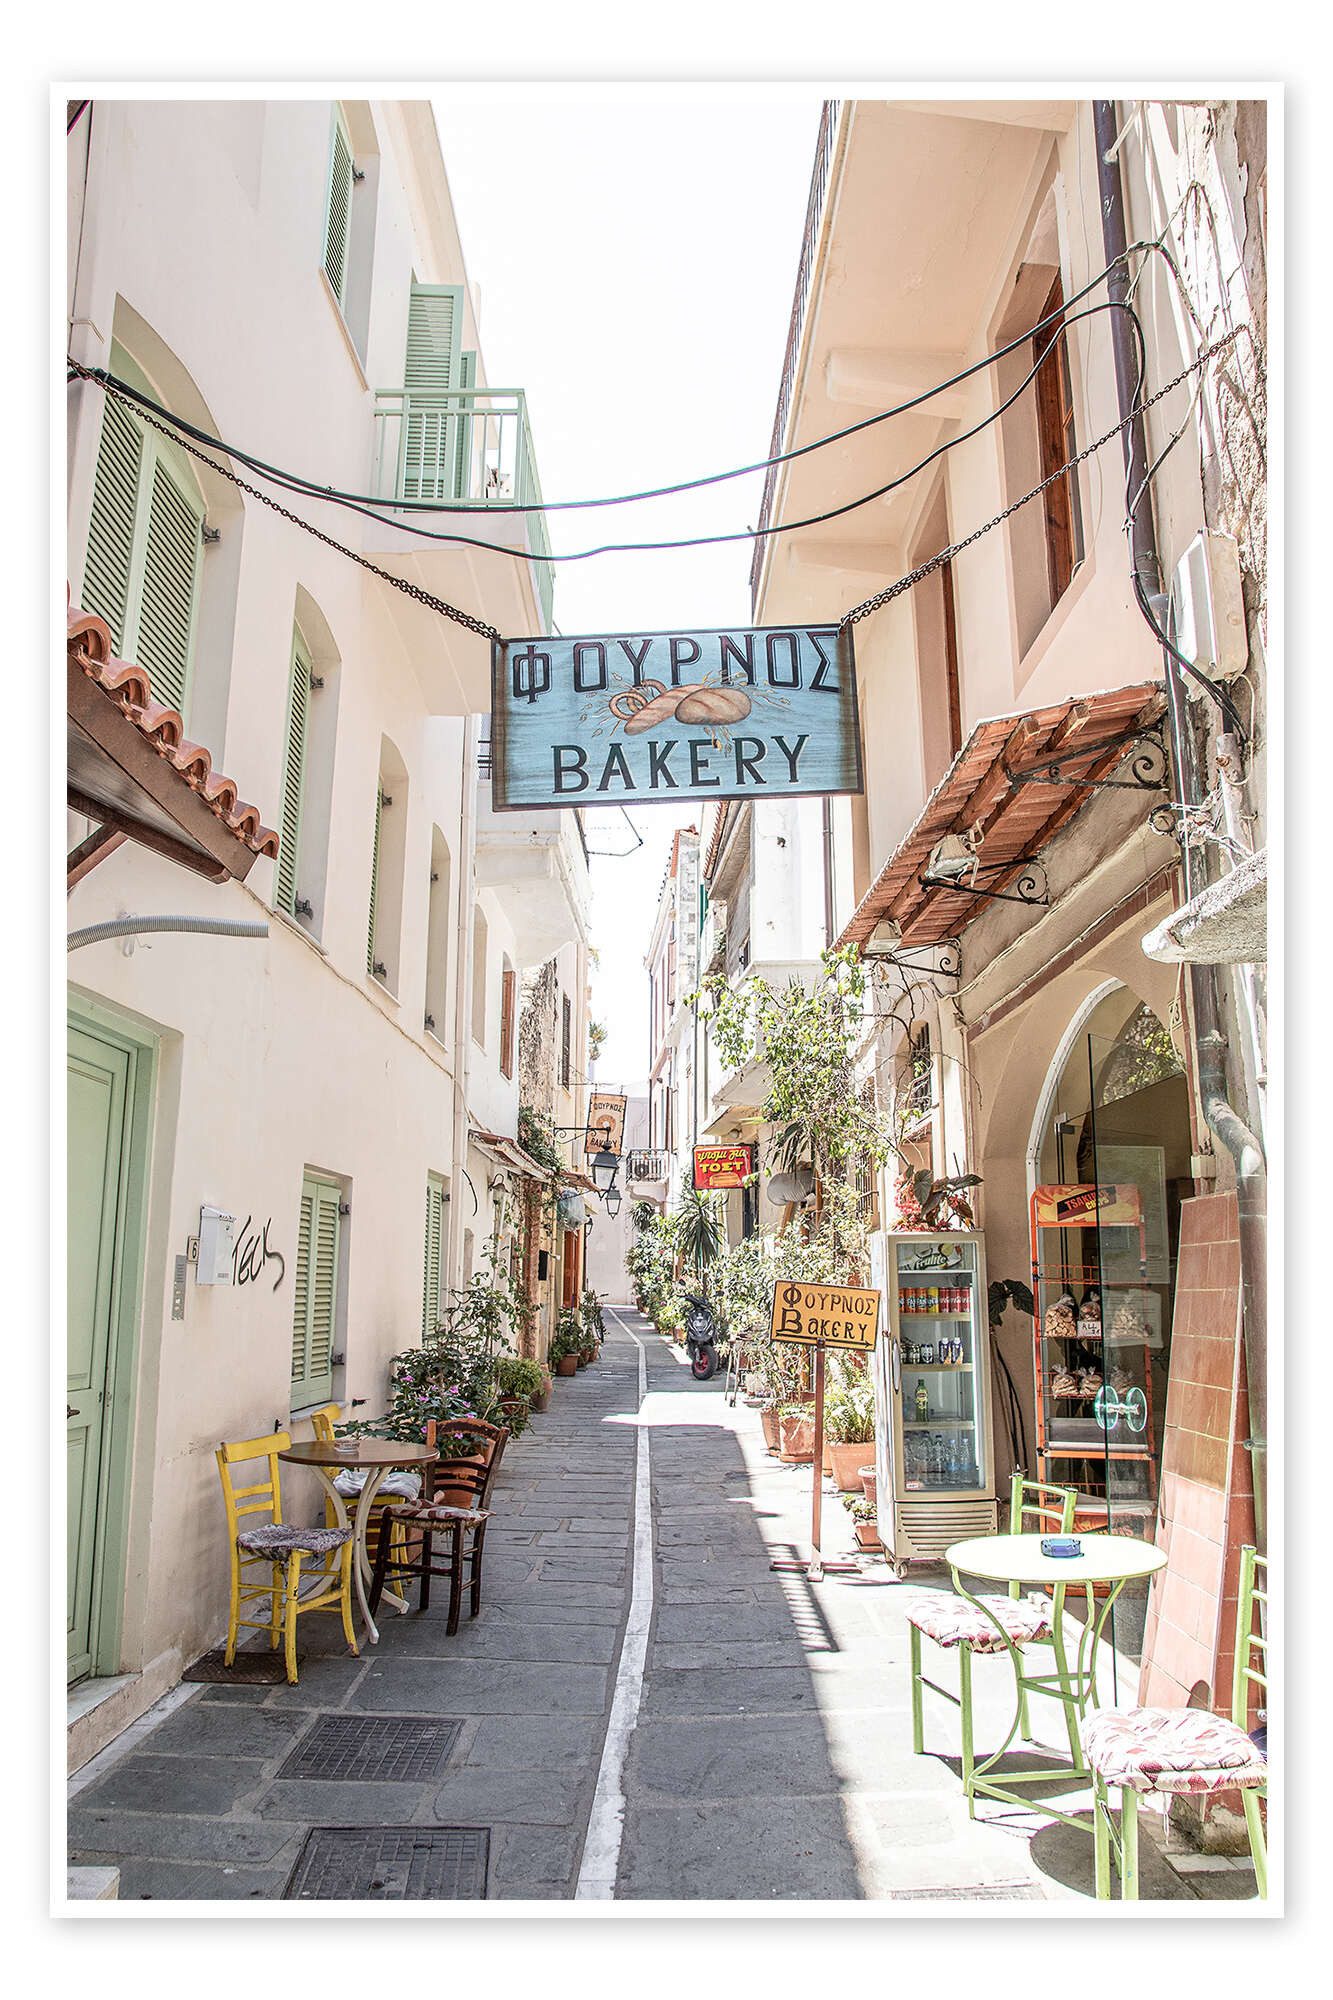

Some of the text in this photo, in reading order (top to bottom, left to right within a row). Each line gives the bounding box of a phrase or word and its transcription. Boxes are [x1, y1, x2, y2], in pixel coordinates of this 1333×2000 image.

[512, 631, 841, 704] ΦΟΥΡΝΟΣ
[551, 734, 810, 794] BAKERY
[590, 1137, 618, 1148] BAKY
[783, 1283, 875, 1316] ΦΟΥΡΝΟΣ
